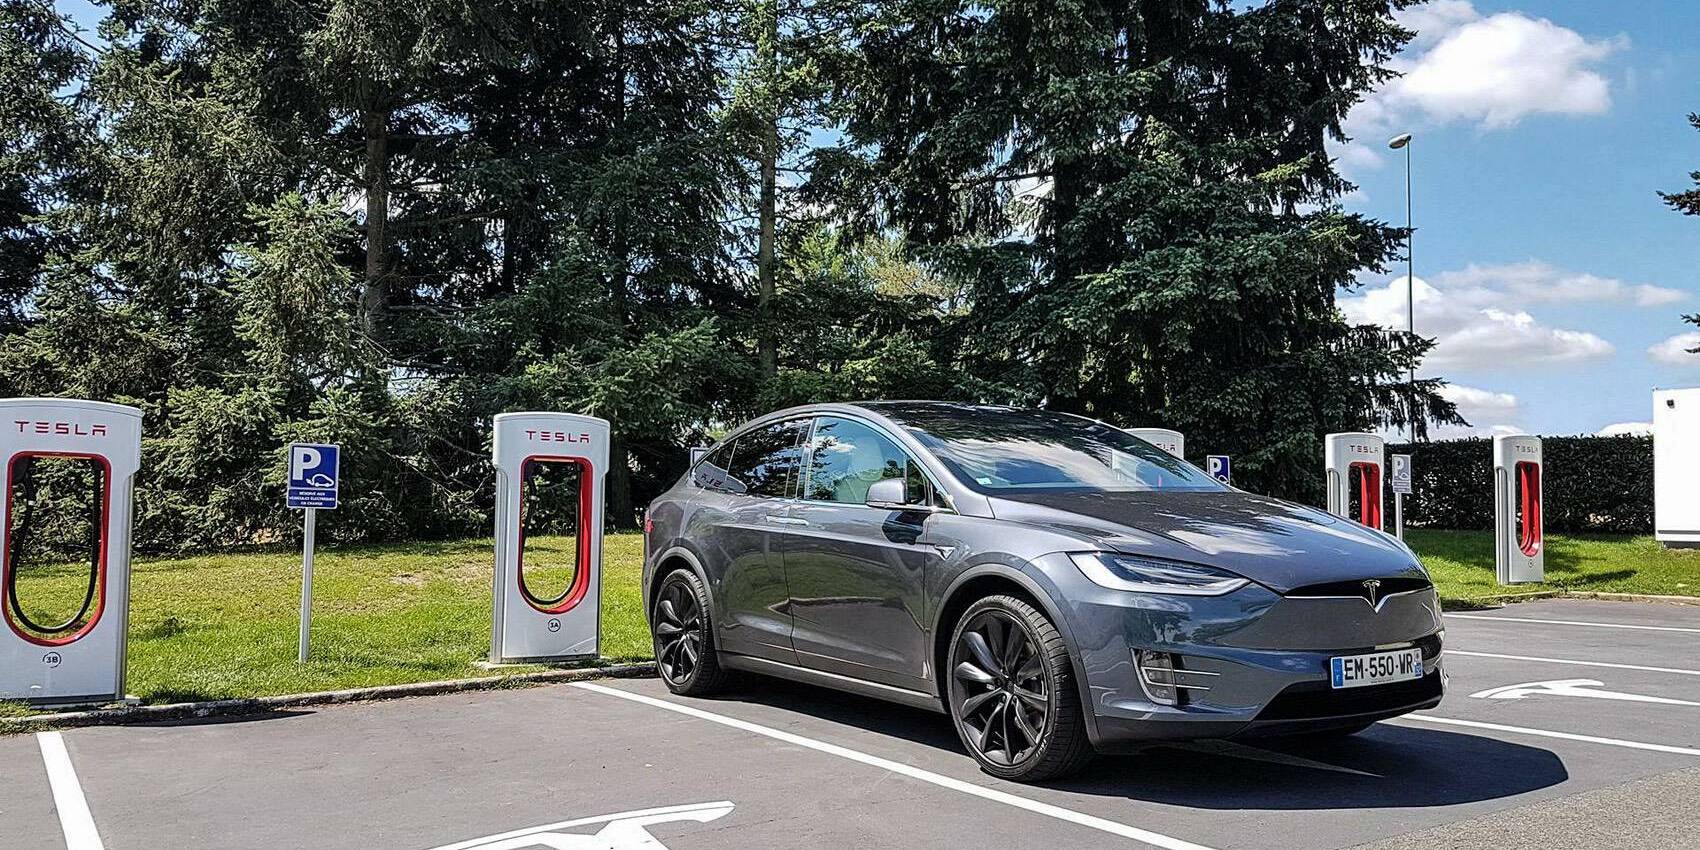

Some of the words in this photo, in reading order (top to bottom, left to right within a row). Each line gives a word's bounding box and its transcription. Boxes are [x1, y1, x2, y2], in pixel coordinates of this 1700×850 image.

[14, 420, 107, 437] TESLA
[525, 430, 590, 444] TESLA
[293, 447, 322, 480] P
[1210, 458, 1222, 478] P
